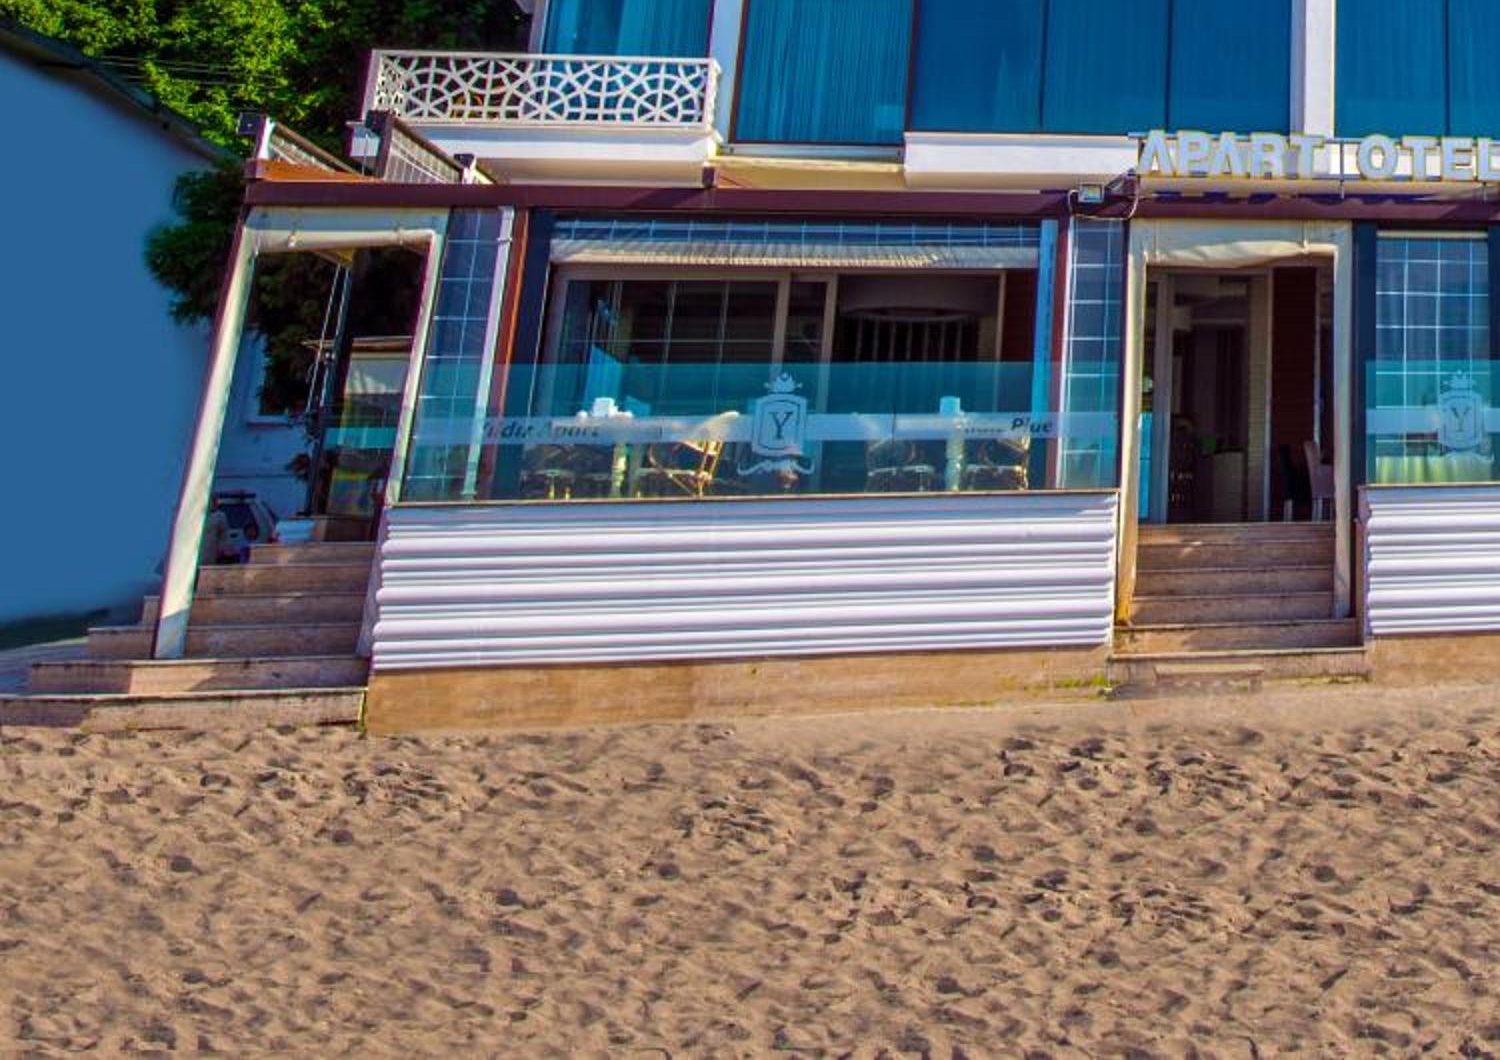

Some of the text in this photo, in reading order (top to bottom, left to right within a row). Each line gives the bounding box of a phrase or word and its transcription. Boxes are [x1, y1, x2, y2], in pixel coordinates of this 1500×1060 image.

[1137, 128, 1327, 180] APART
[768, 411, 793, 440] Y
[1451, 406, 1471, 433] Y
